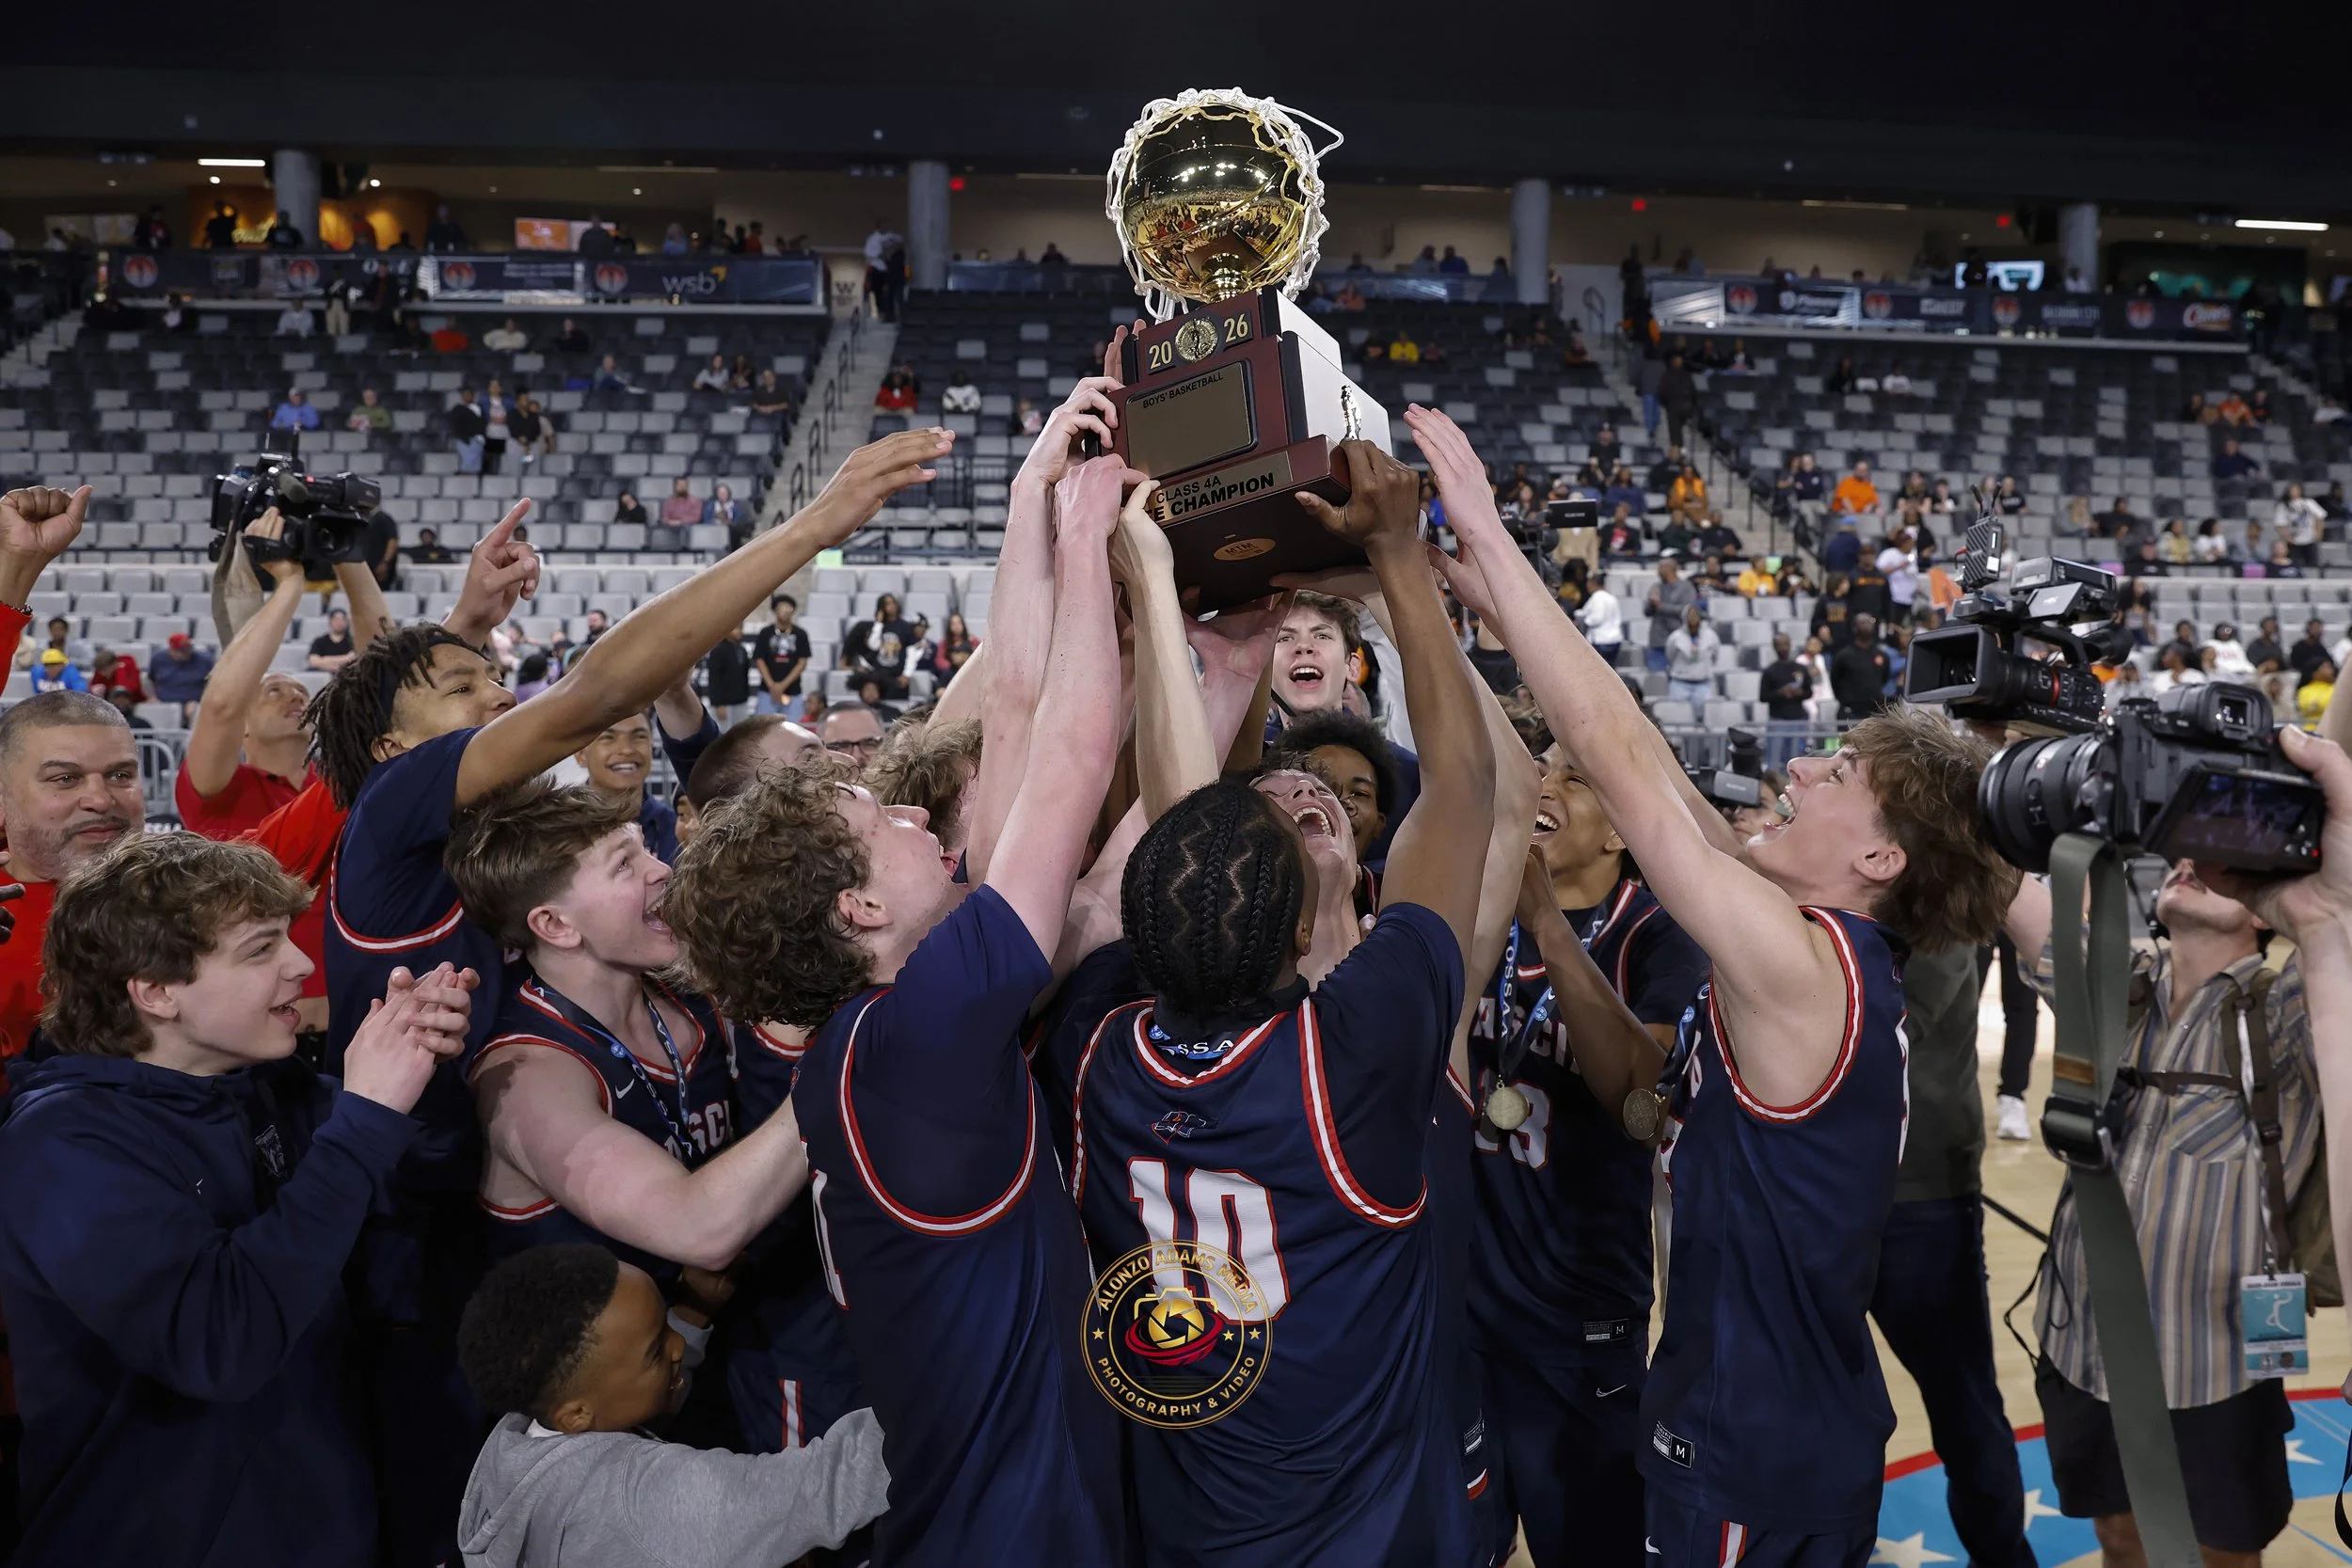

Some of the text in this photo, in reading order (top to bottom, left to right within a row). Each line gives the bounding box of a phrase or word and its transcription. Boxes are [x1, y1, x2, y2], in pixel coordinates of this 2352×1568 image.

[661, 270, 716, 294] wsb
[1148, 313, 1248, 370] 20 26
[1142, 372, 1223, 409] BOYS' BASKETBALL
[1155, 475, 1221, 504] CLASS 4A
[1170, 472, 1275, 516] CHAMPION
[1501, 944, 1516, 1038] OSSAA
[1127, 1156, 1291, 1325] 10
[1615, 1325, 1625, 1335] M
[1676, 1444, 1686, 1459] M
